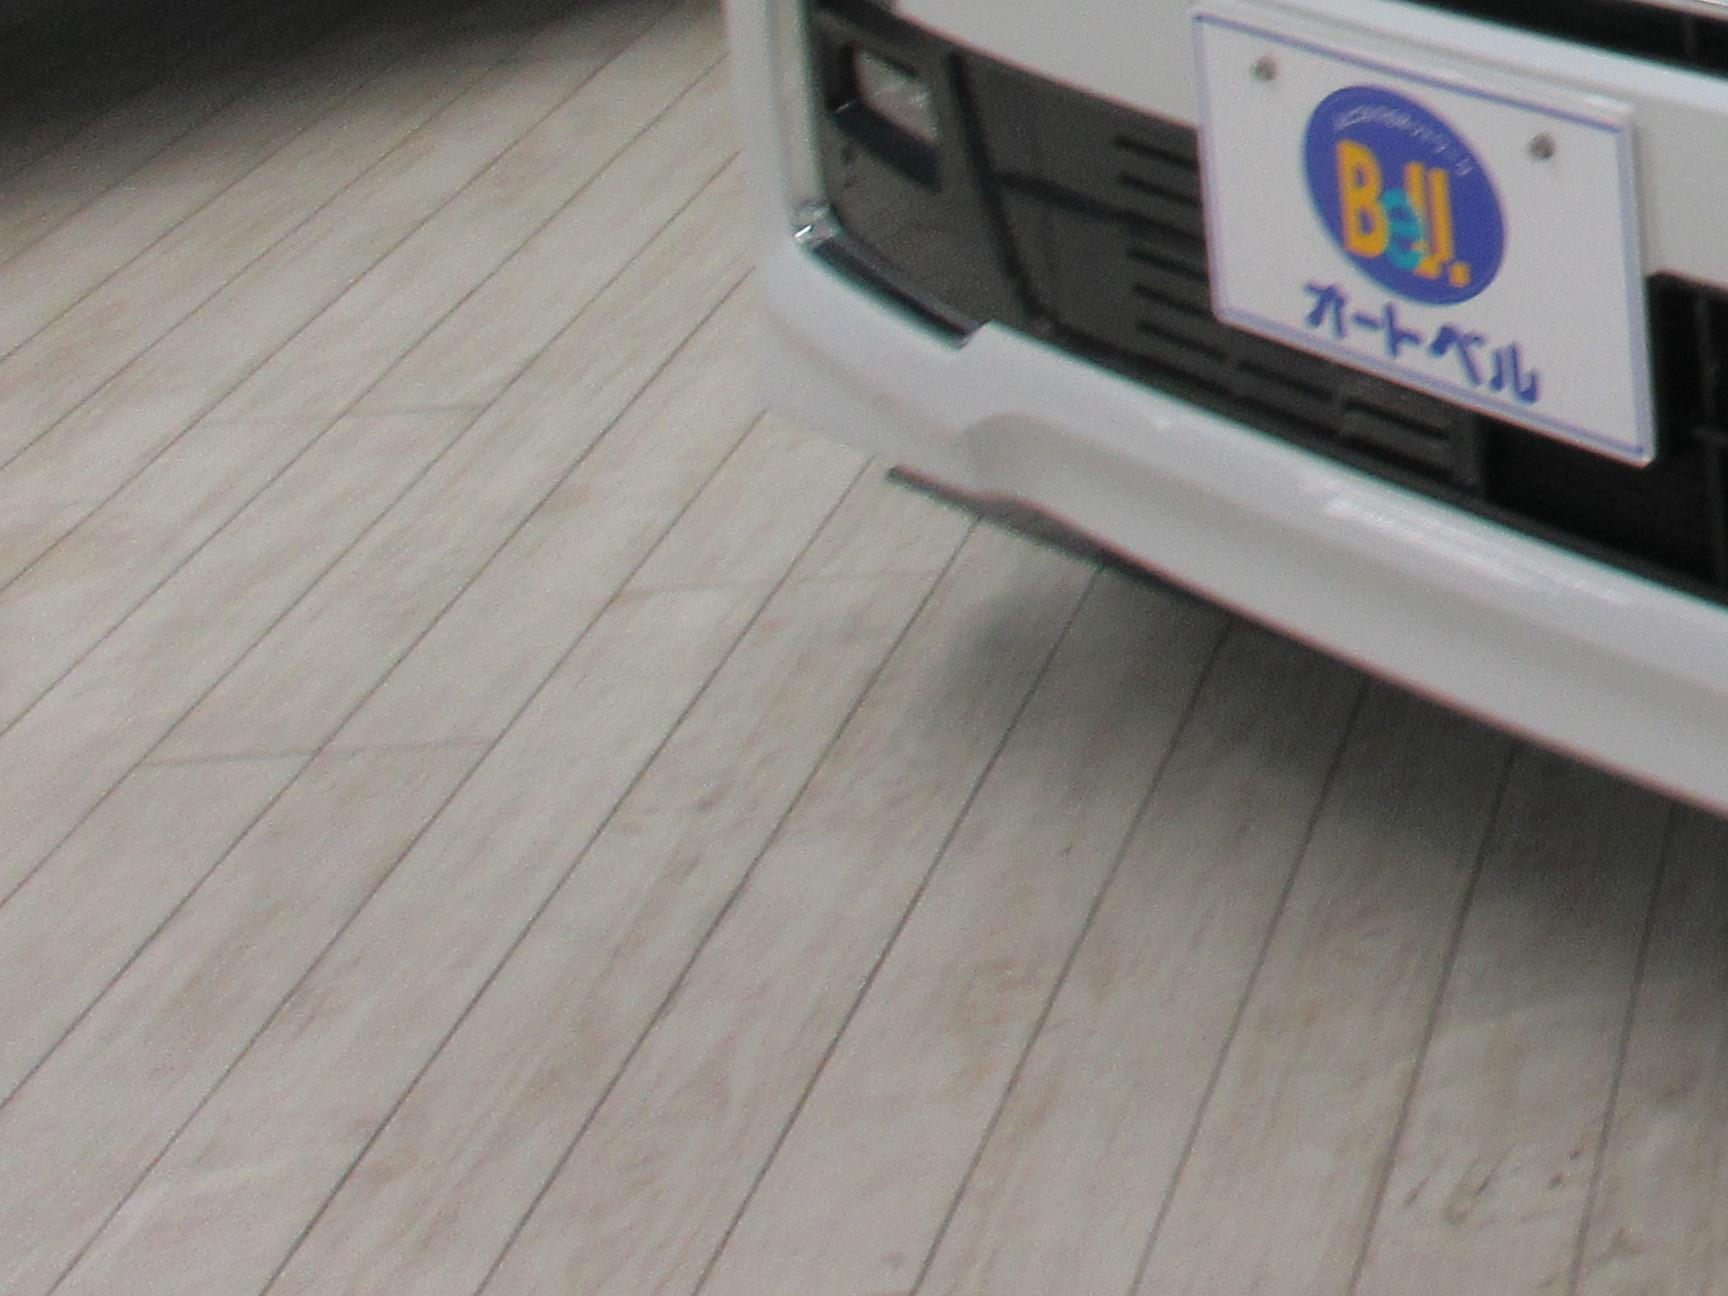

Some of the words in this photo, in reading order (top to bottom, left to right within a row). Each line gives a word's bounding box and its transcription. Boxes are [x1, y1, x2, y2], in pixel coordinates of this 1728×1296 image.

[1304, 281, 1540, 404] オートベル
